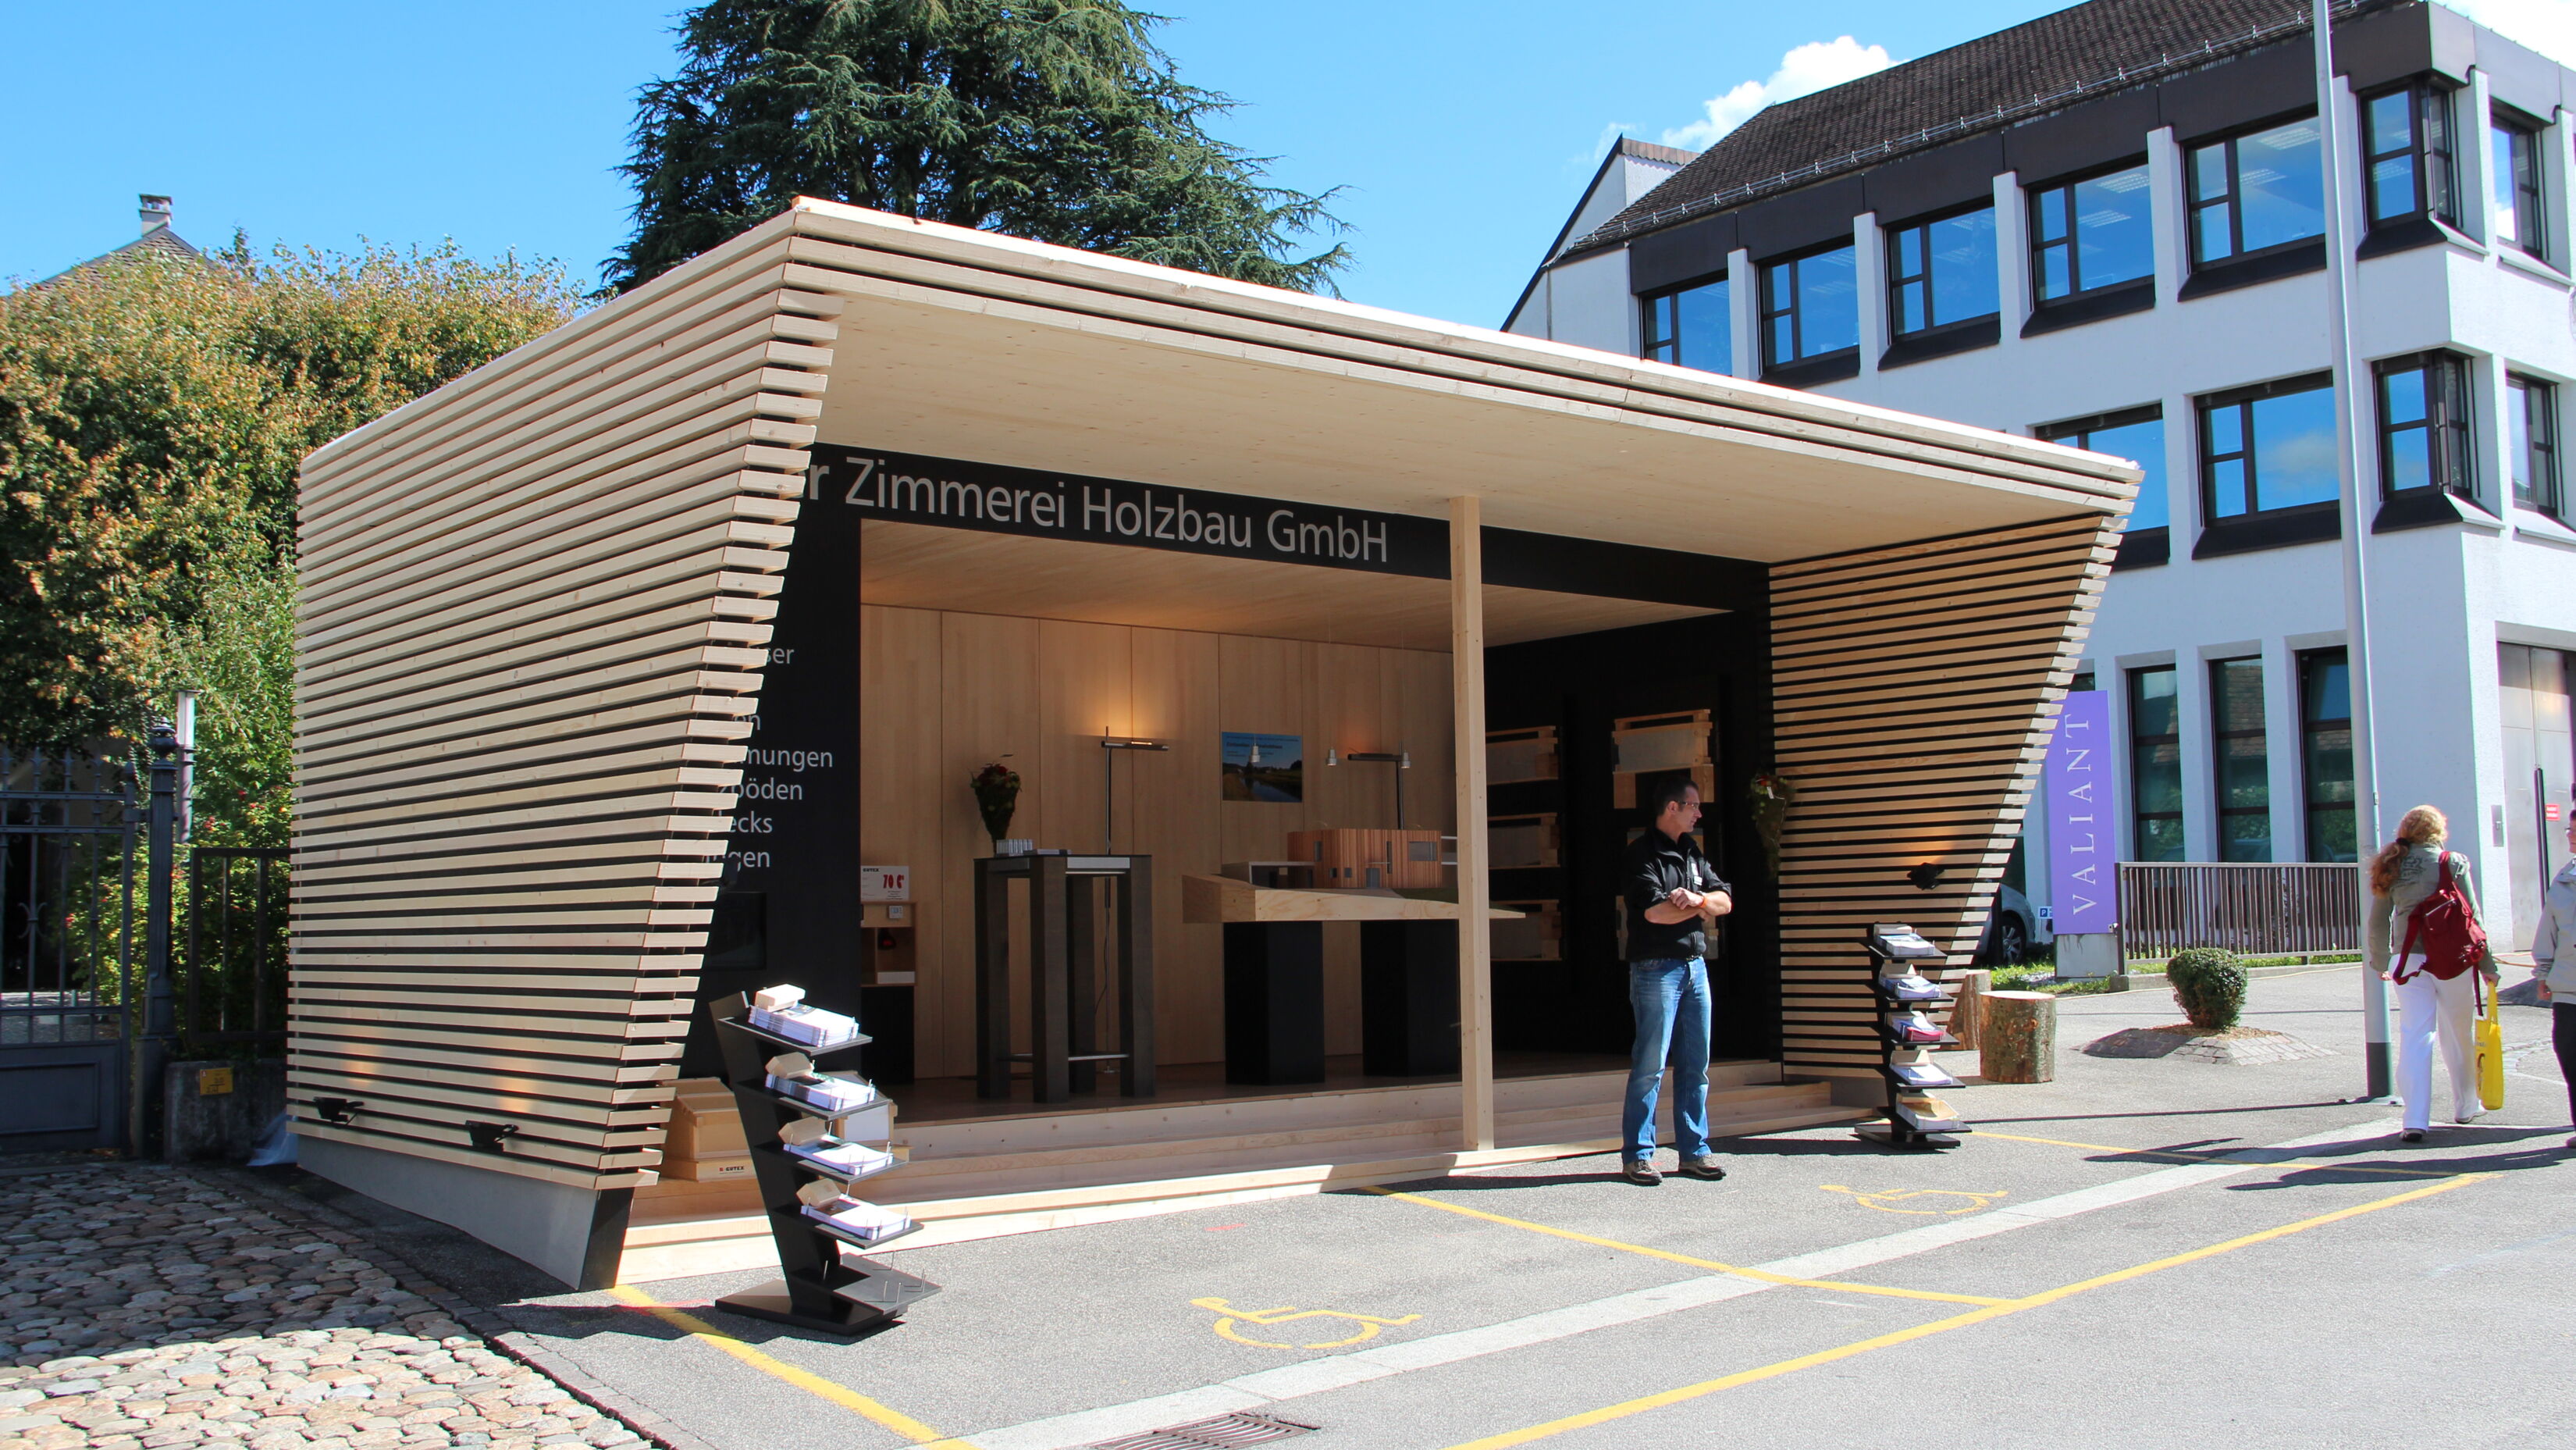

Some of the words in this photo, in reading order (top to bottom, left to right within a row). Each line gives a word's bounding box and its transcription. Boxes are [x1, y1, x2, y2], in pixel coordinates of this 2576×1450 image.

[845, 457, 1066, 528] Zimmerei
[1083, 486, 1251, 548] Holzbau
[1267, 509, 1387, 562] GmbH
[2065, 714, 2097, 915] VALIANT
